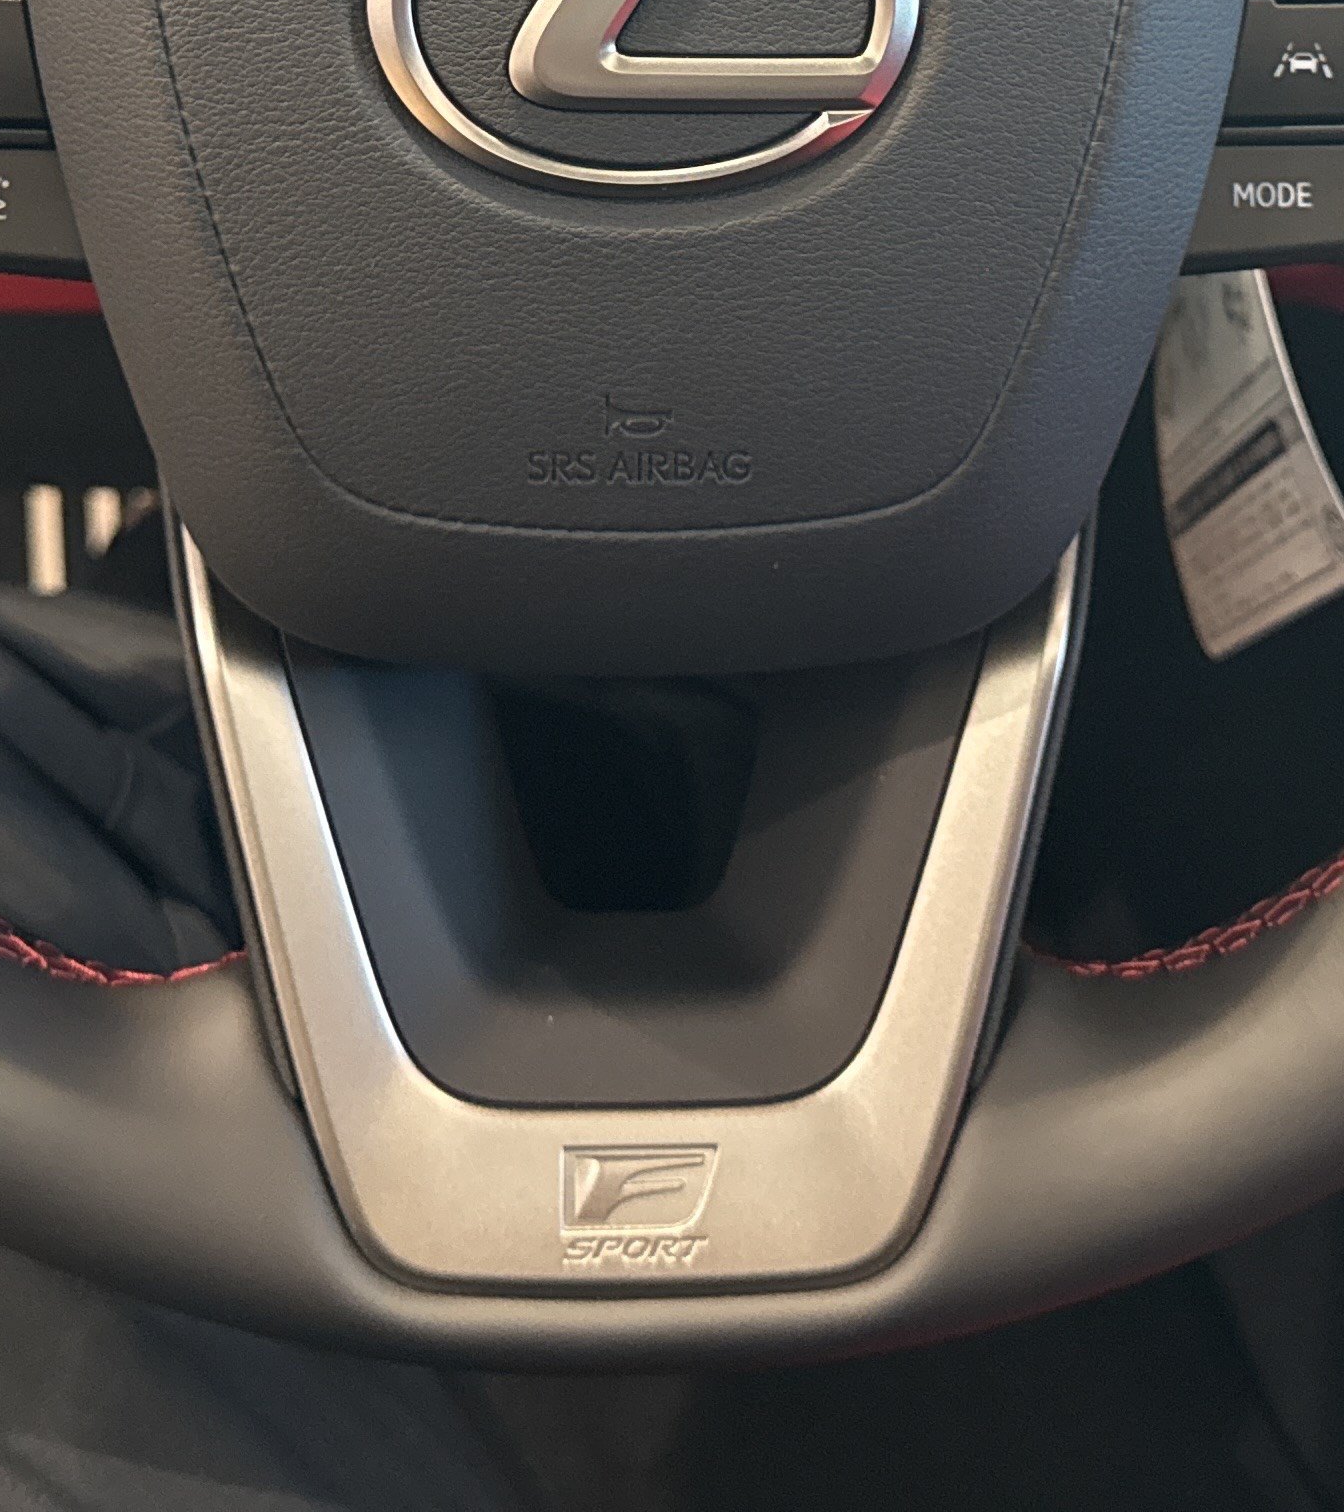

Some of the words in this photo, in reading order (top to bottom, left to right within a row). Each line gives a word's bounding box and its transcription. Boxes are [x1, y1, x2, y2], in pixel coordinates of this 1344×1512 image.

[1232, 181, 1313, 208] MODE
[528, 450, 599, 485] SRS
[606, 450, 755, 485] AIRBAG
[562, 1236, 709, 1264] SPORT
